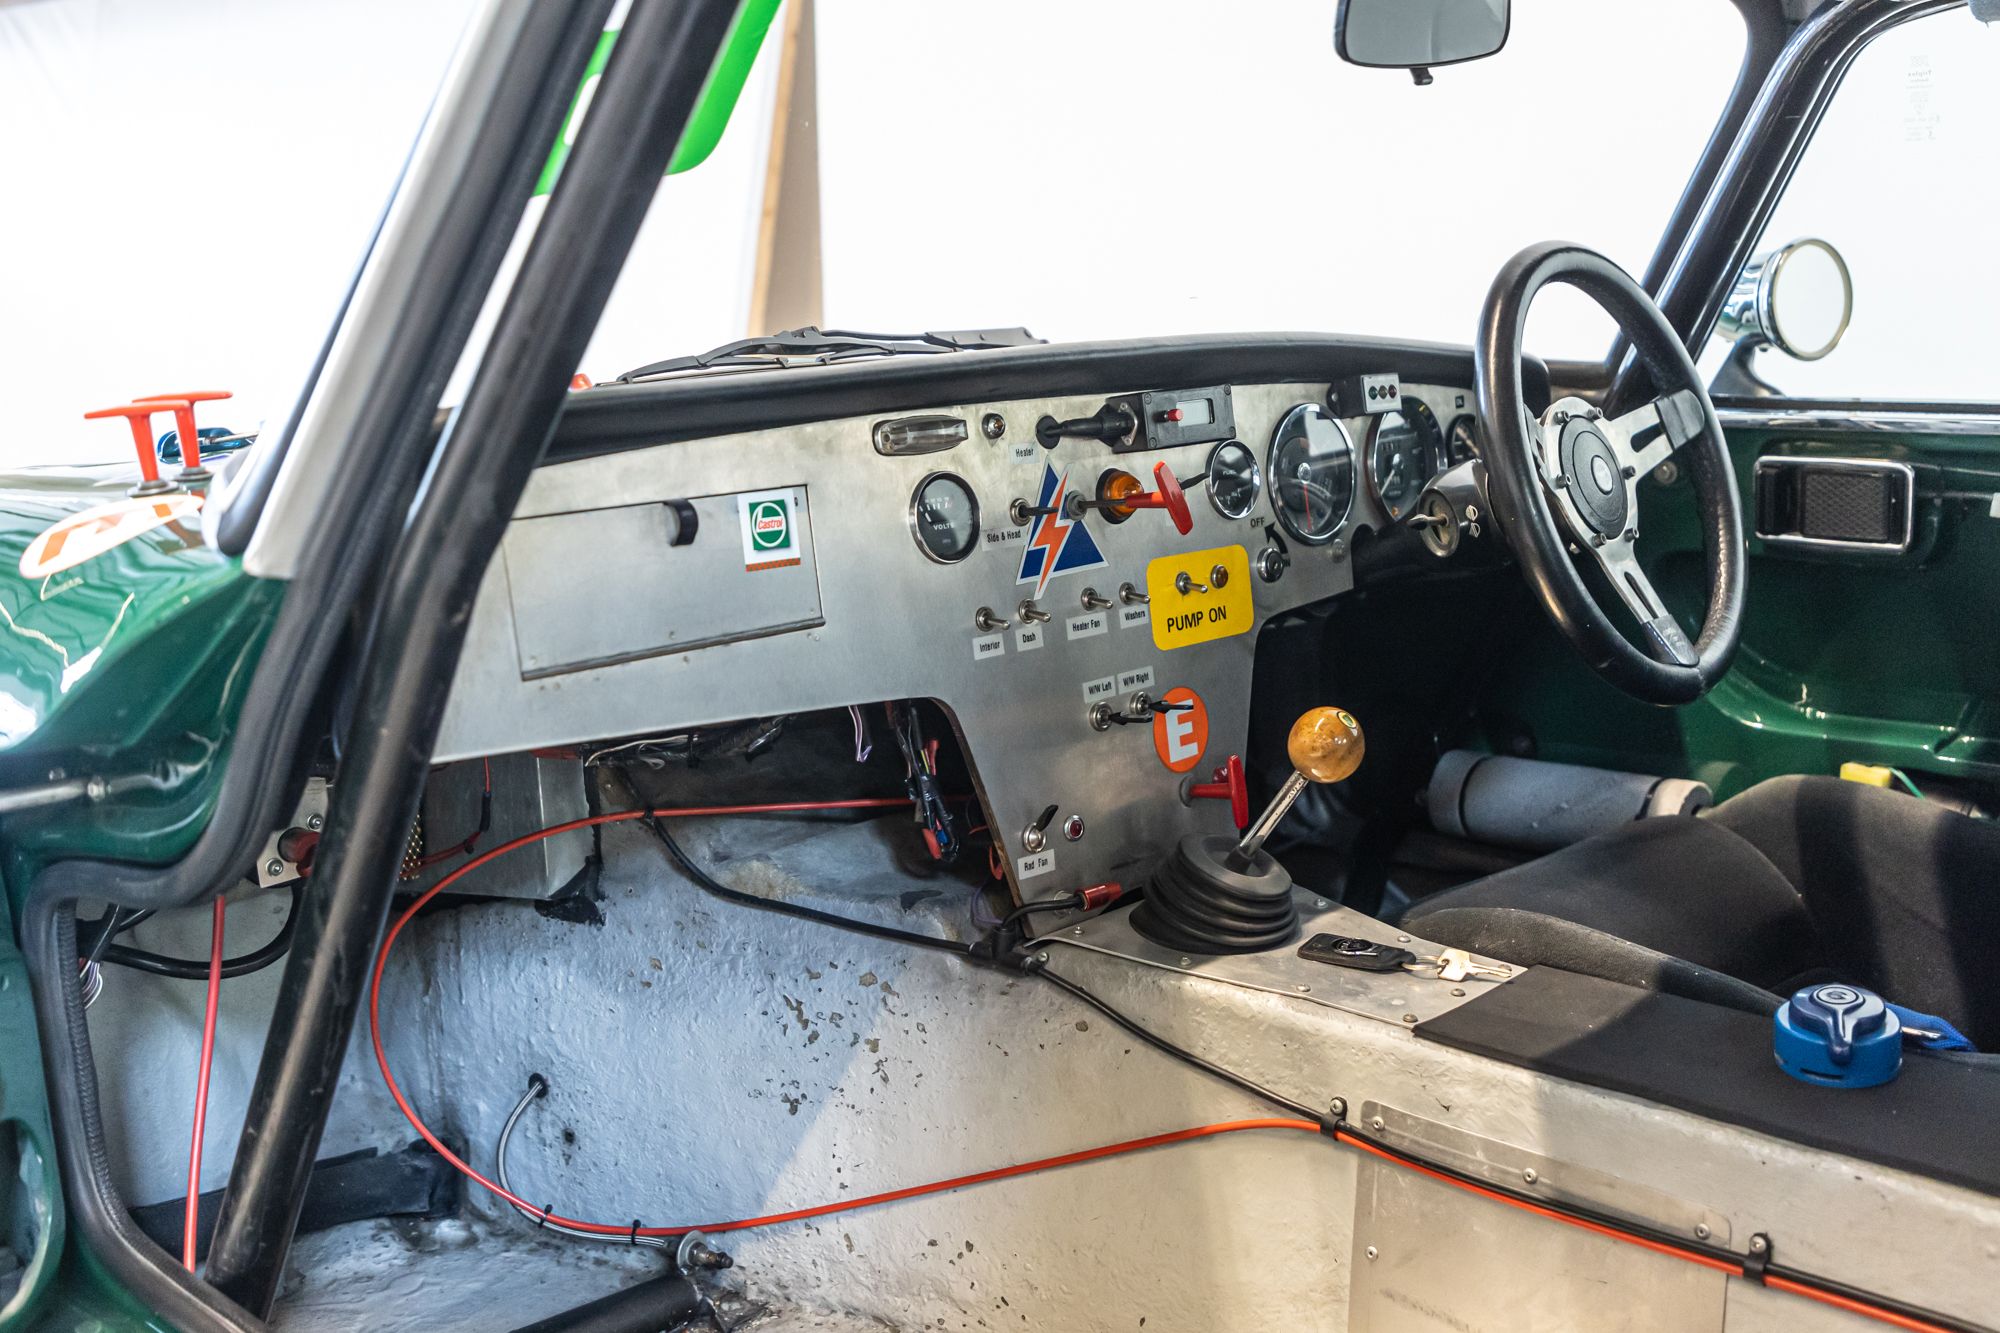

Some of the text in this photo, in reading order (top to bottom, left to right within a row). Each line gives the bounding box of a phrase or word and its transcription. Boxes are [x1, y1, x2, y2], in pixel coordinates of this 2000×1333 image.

[1015, 448, 1034, 458] Heater
[757, 517, 784, 530] Castrol
[1250, 517, 1265, 528] OFF
[986, 529, 1021, 543] Side & Head
[1124, 610, 1146, 621] Washers
[1166, 605, 1227, 633] PUMP ON
[1072, 618, 1101, 632] Heater Fan
[1022, 632, 1037, 643] Dash
[979, 641, 1001, 653] Interior
[1123, 672, 1150, 687] W/W Right
[1087, 680, 1113, 695] W/W Left
[1164, 698, 1199, 764] E
[1023, 858, 1049, 871] Rad Fan
